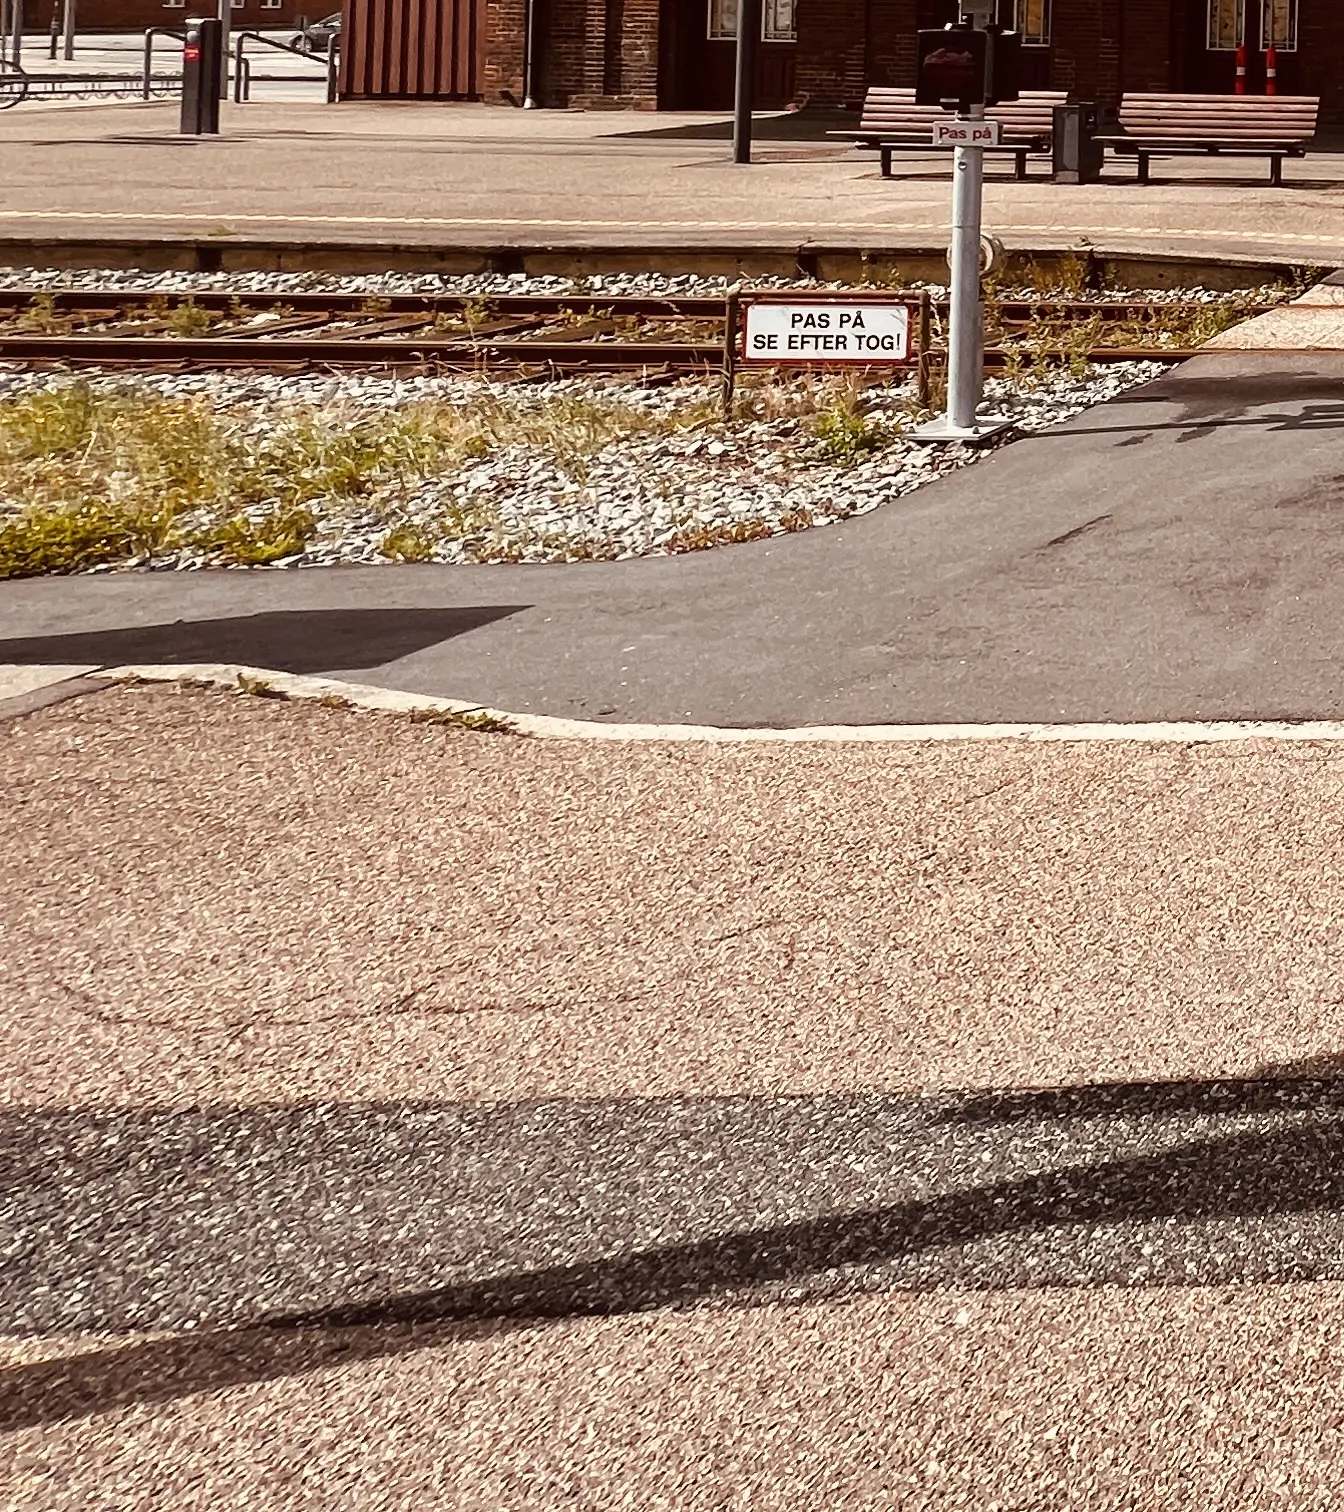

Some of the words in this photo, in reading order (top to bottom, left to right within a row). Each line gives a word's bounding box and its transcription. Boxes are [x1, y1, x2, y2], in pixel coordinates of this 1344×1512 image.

[939, 127, 967, 139] Pas
[972, 127, 992, 141] på
[791, 313, 830, 329] PAS
[839, 311, 865, 329] PÅ
[753, 334, 779, 350] SE
[788, 334, 848, 351] EFTER
[854, 333, 901, 351] TOG!
